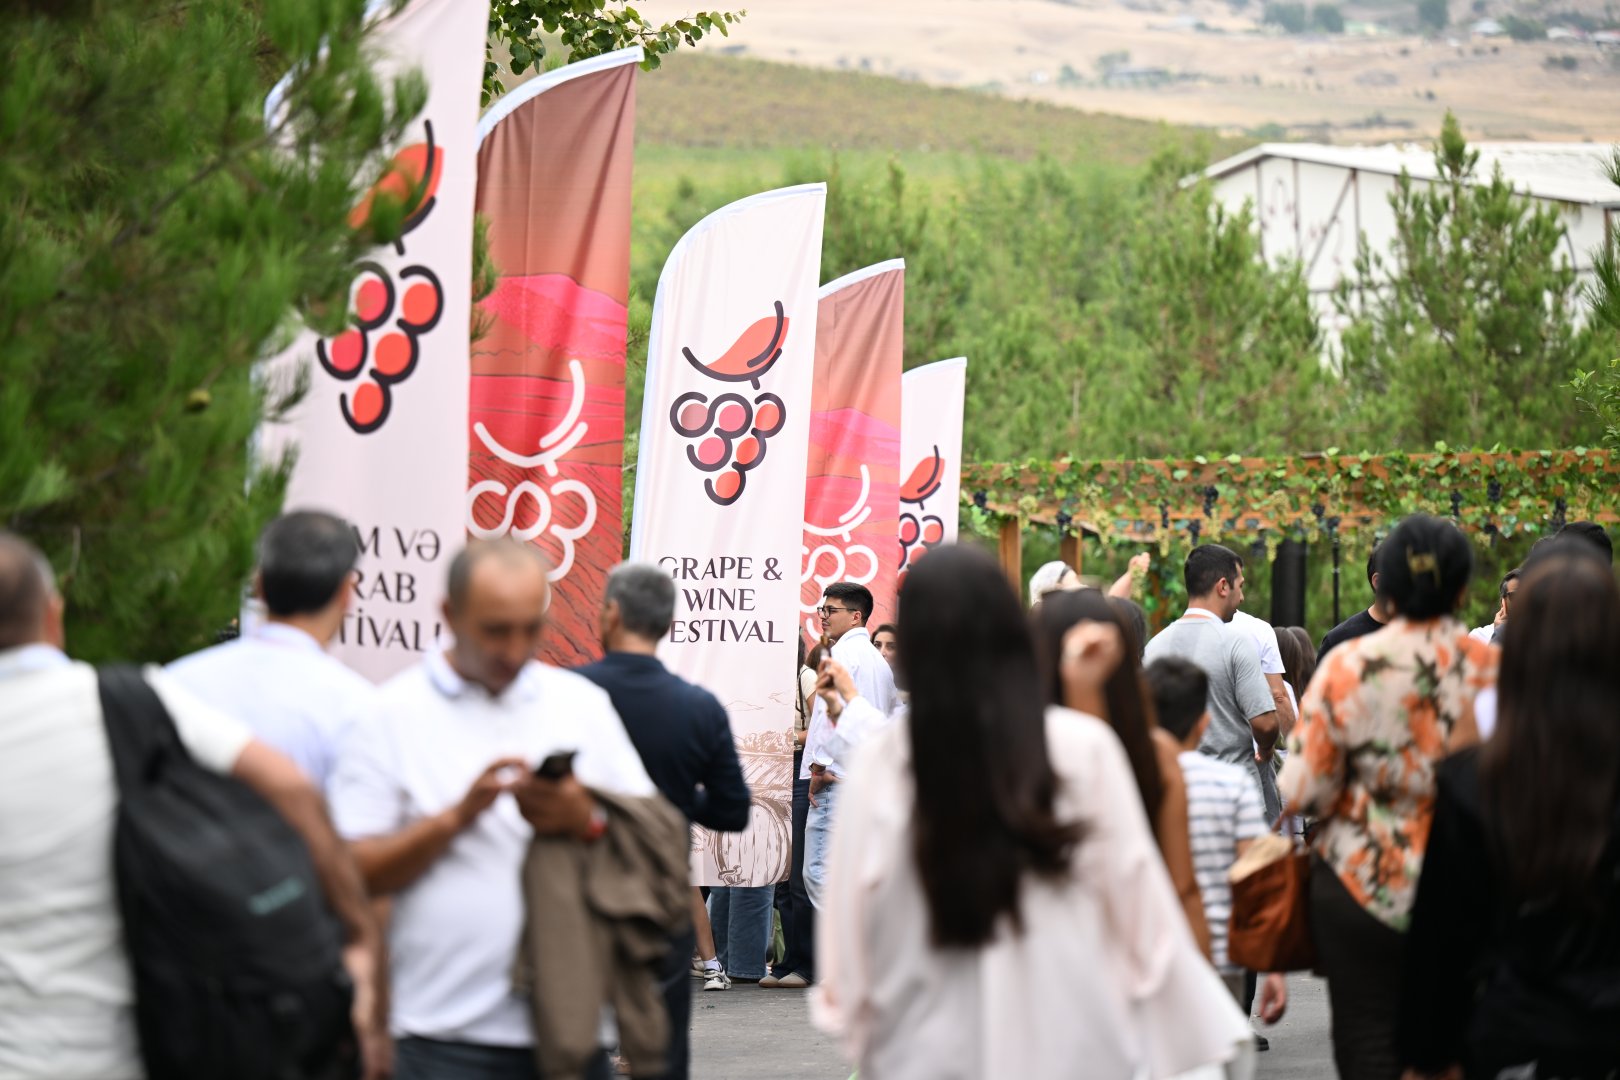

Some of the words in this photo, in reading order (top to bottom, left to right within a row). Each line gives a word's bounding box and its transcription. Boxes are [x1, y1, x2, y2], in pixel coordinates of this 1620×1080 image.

[393, 527, 440, 562] VƏ
[763, 557, 783, 581] &
[351, 570, 416, 603] RAB
[682, 588, 756, 612] WINE
[669, 619, 784, 643] ESTIVAL
